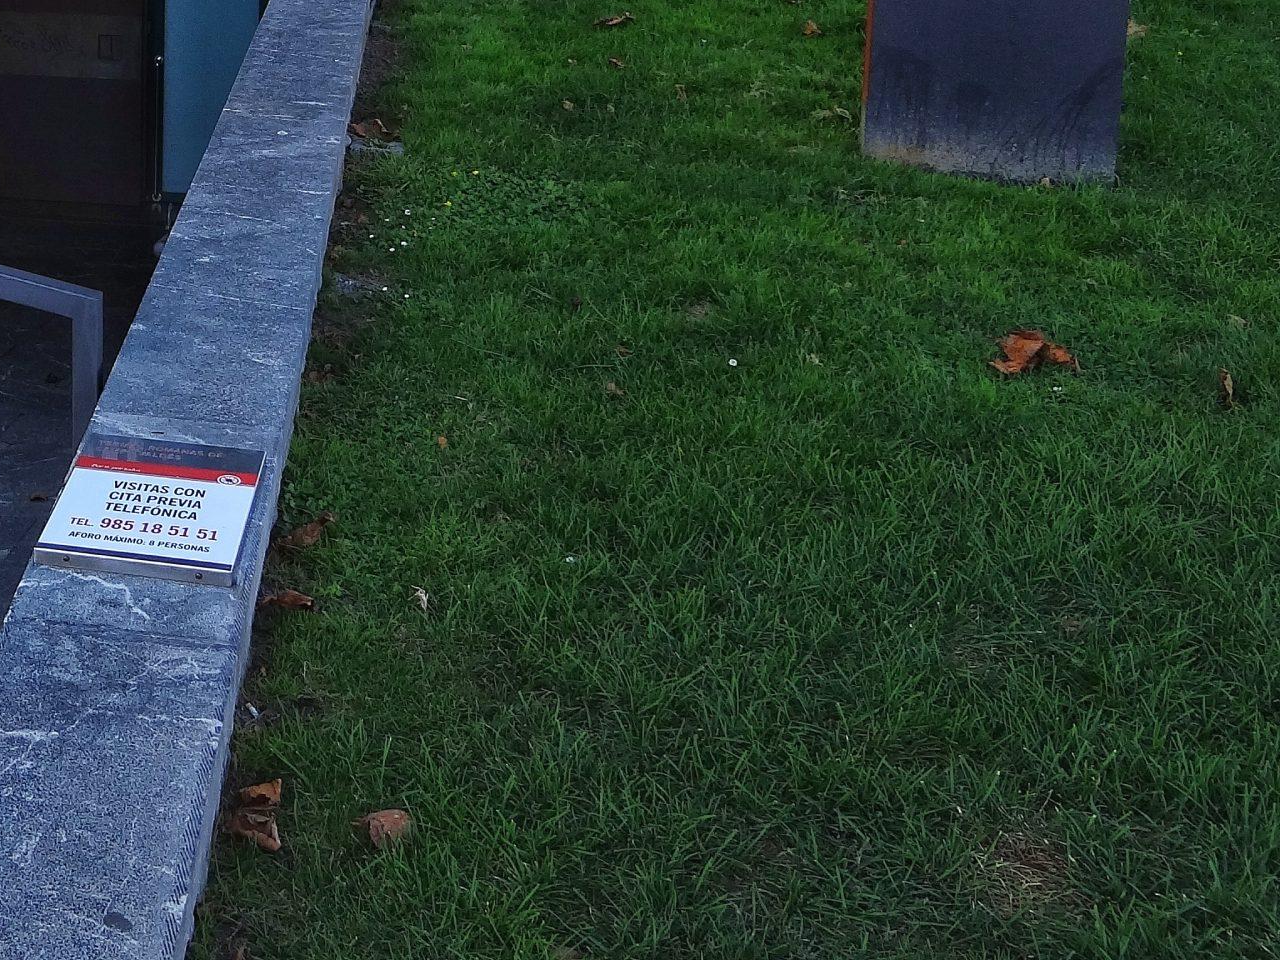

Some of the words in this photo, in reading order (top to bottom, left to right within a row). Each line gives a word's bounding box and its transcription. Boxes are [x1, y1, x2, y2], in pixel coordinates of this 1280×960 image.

[114, 480, 170, 494] VISITAS
[173, 487, 206, 498] CON
[109, 491, 142, 503] CITA
[146, 495, 202, 509] PREVIA
[105, 502, 198, 520] TELEFÓNICA
[70, 516, 94, 527] TEL.
[100, 517, 134, 531] 985
[139, 522, 163, 534] 18
[168, 525, 189, 537] 51
[196, 528, 218, 541] 51
[68, 531, 101, 540] AFORO
[157, 541, 210, 553] PERSONAS
